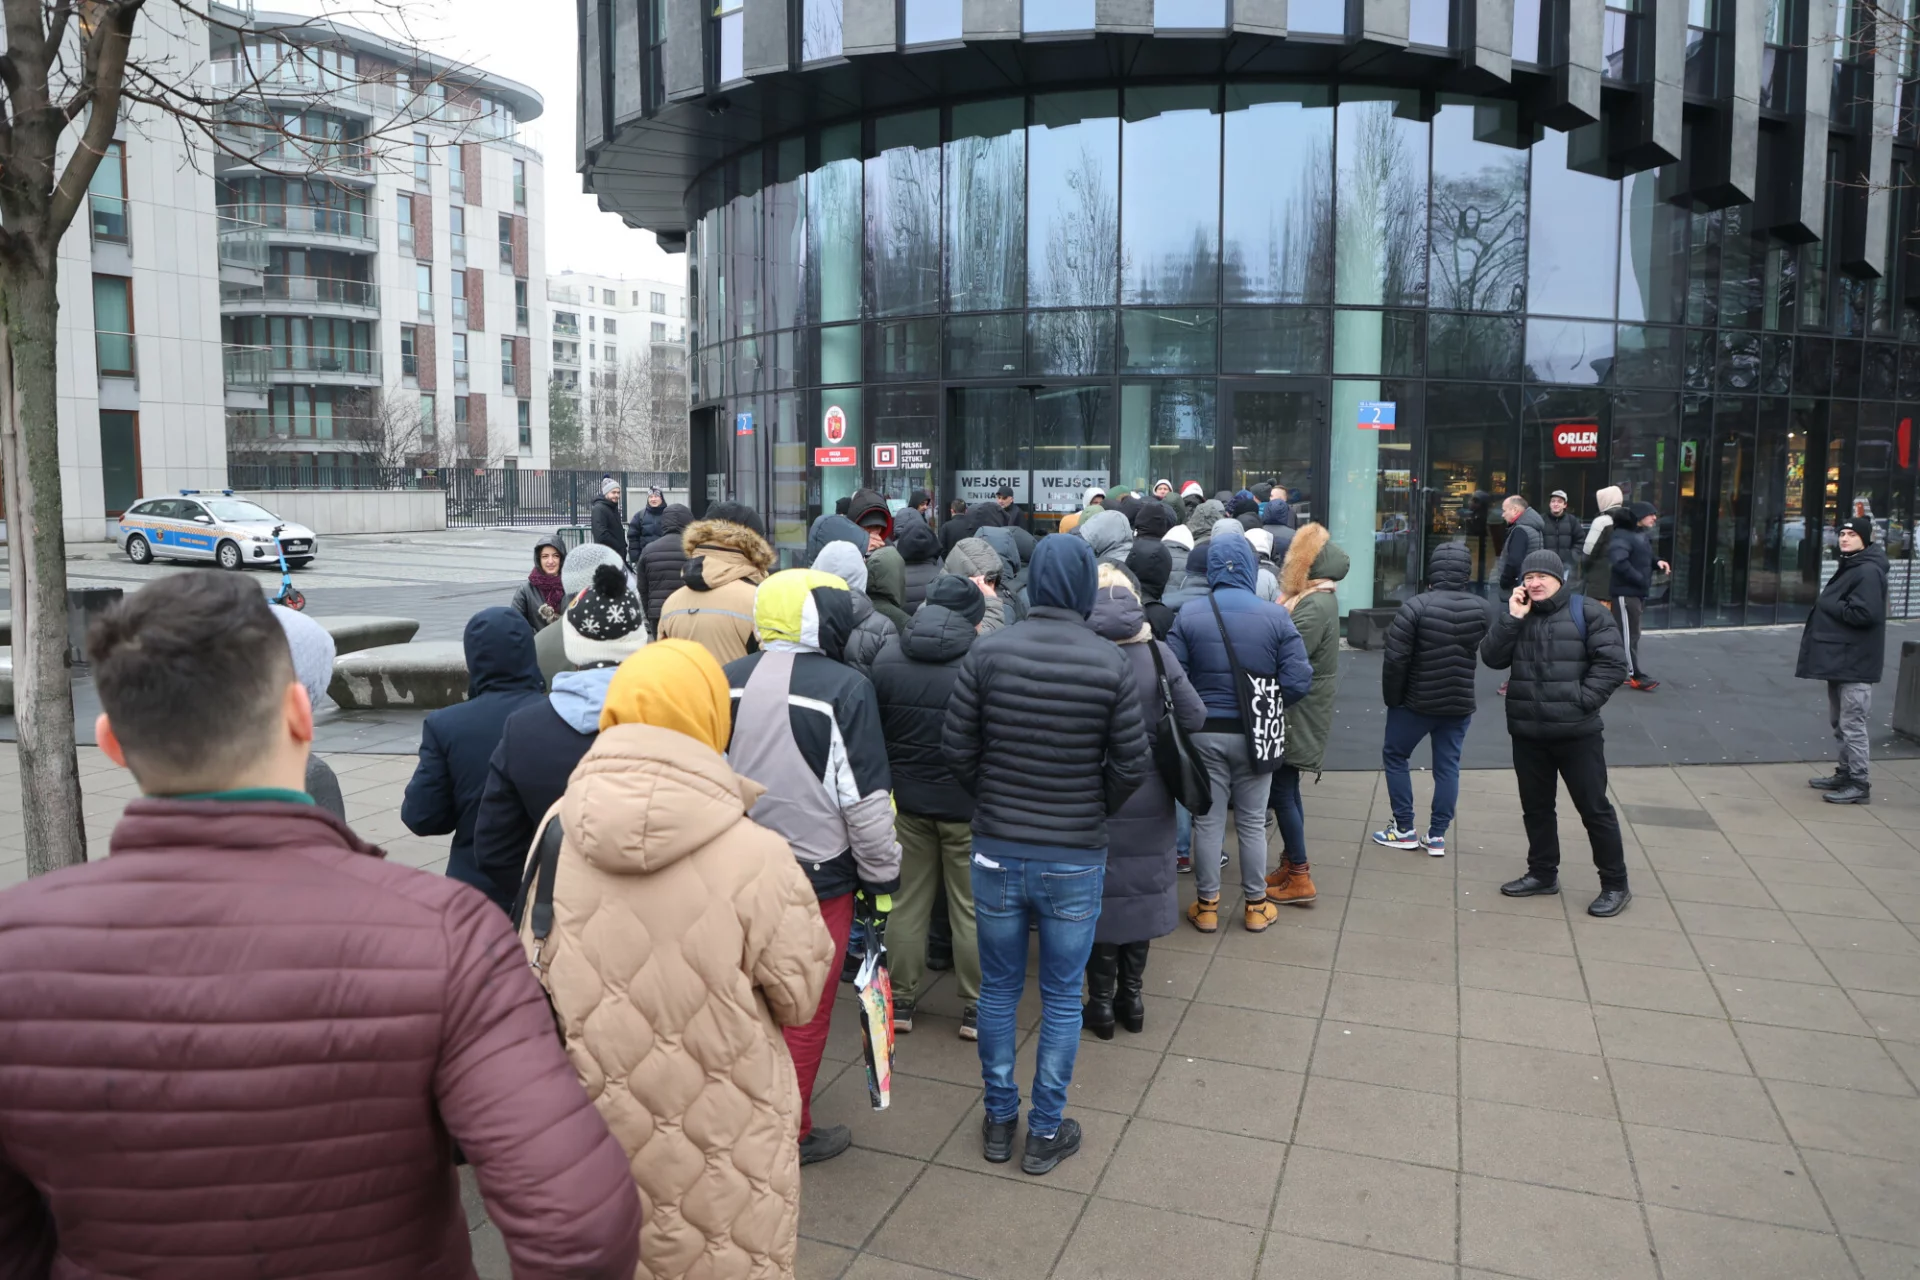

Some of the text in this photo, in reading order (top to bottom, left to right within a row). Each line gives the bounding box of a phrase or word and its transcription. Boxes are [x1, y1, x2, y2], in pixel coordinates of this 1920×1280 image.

[1372, 407, 1381, 423] 2
[742, 416, 747, 430] 2
[1558, 432, 1598, 445] ORLEN
[961, 475, 1021, 488] WEJŚCIE
[1042, 475, 1106, 488] WEJŚCIE
[1048, 492, 1084, 500] ENTRAN
